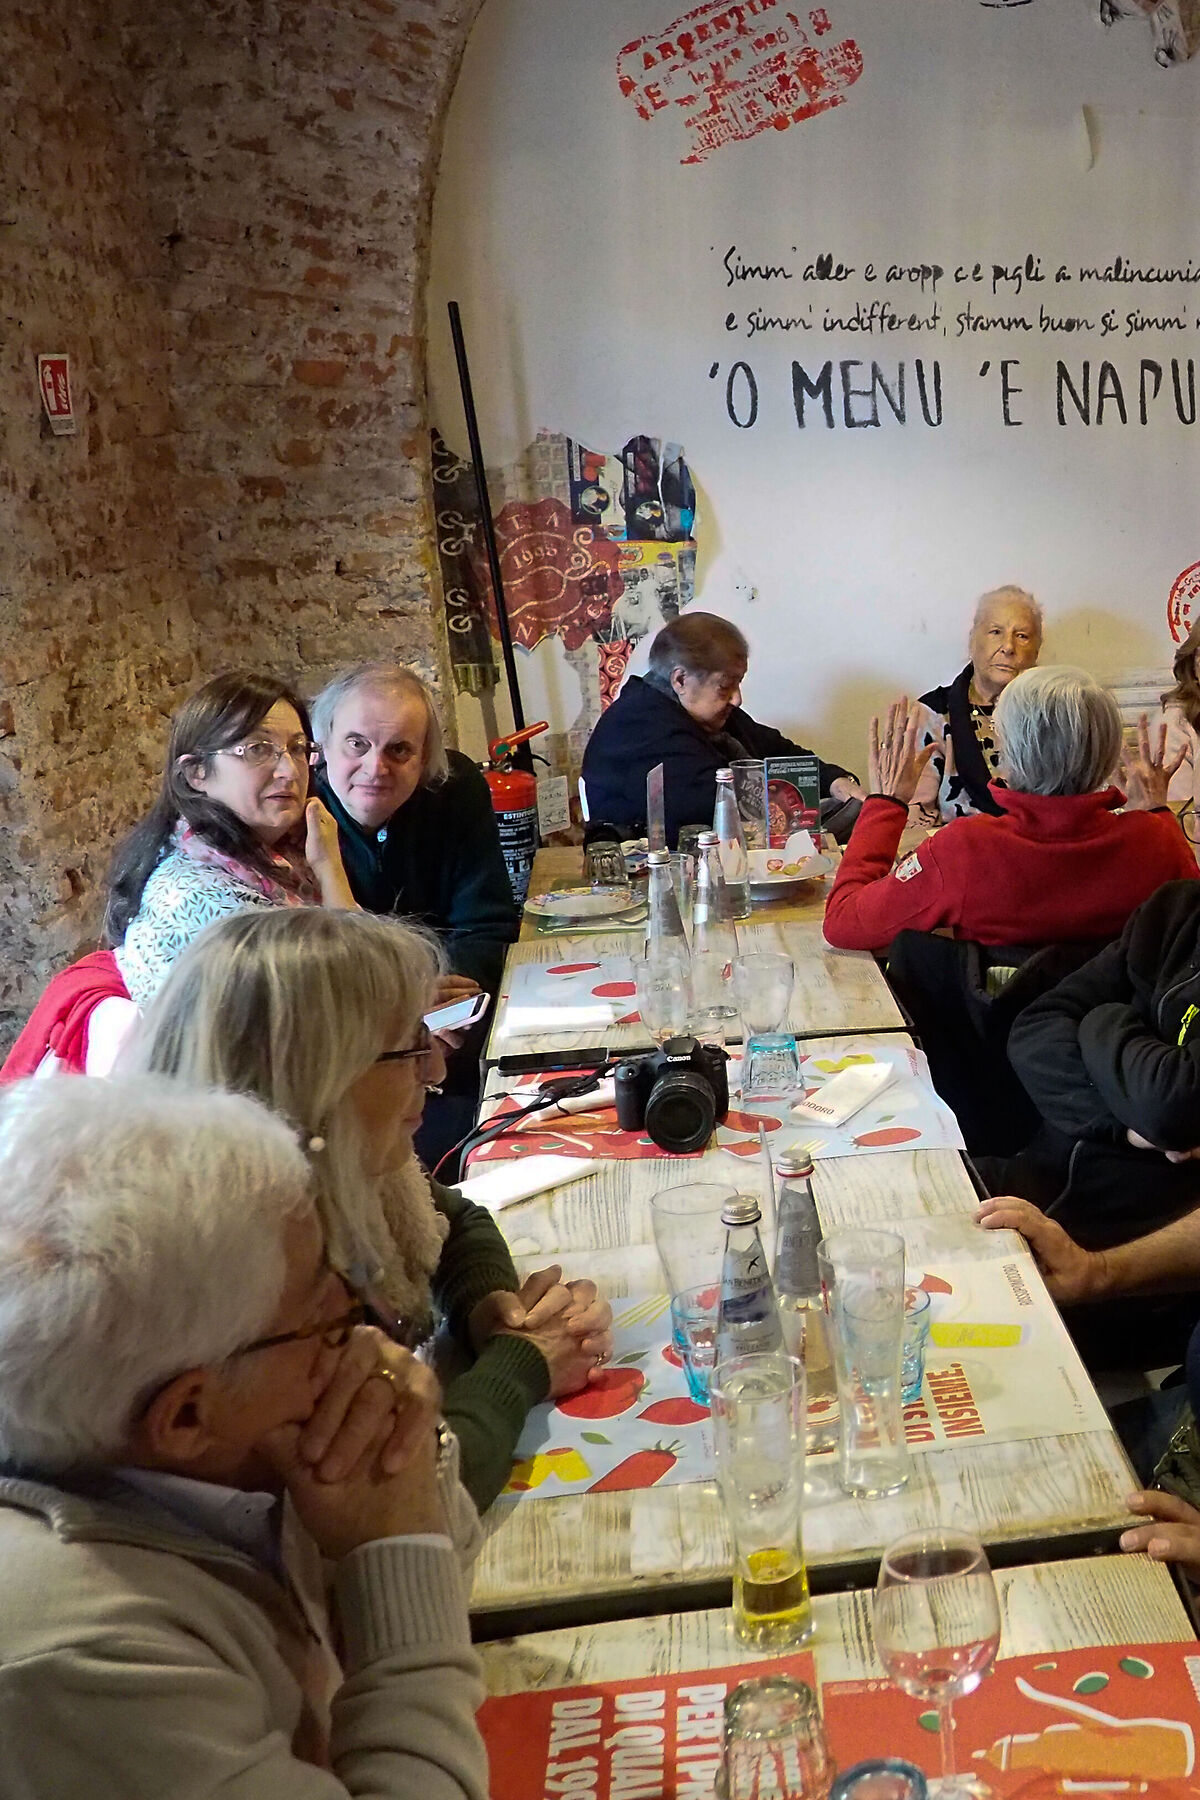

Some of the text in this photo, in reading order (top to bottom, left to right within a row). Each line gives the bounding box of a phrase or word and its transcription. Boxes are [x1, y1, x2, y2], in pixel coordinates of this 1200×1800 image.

[864, 263, 878, 283] e
[885, 263, 945, 295] aropp
[1054, 264, 1072, 284] a
[724, 311, 739, 332] e
[955, 300, 1034, 338] stamm
[1039, 303, 1096, 334] buon
[1099, 308, 1120, 338] si
[791, 358, 943, 430] MENU
[666, 1055, 691, 1063] Canon
[926, 1362, 985, 1439] INSIEME.
[548, 1696, 604, 1758] DAL
[614, 1689, 666, 1724] DI
[676, 1682, 727, 1742] PER
